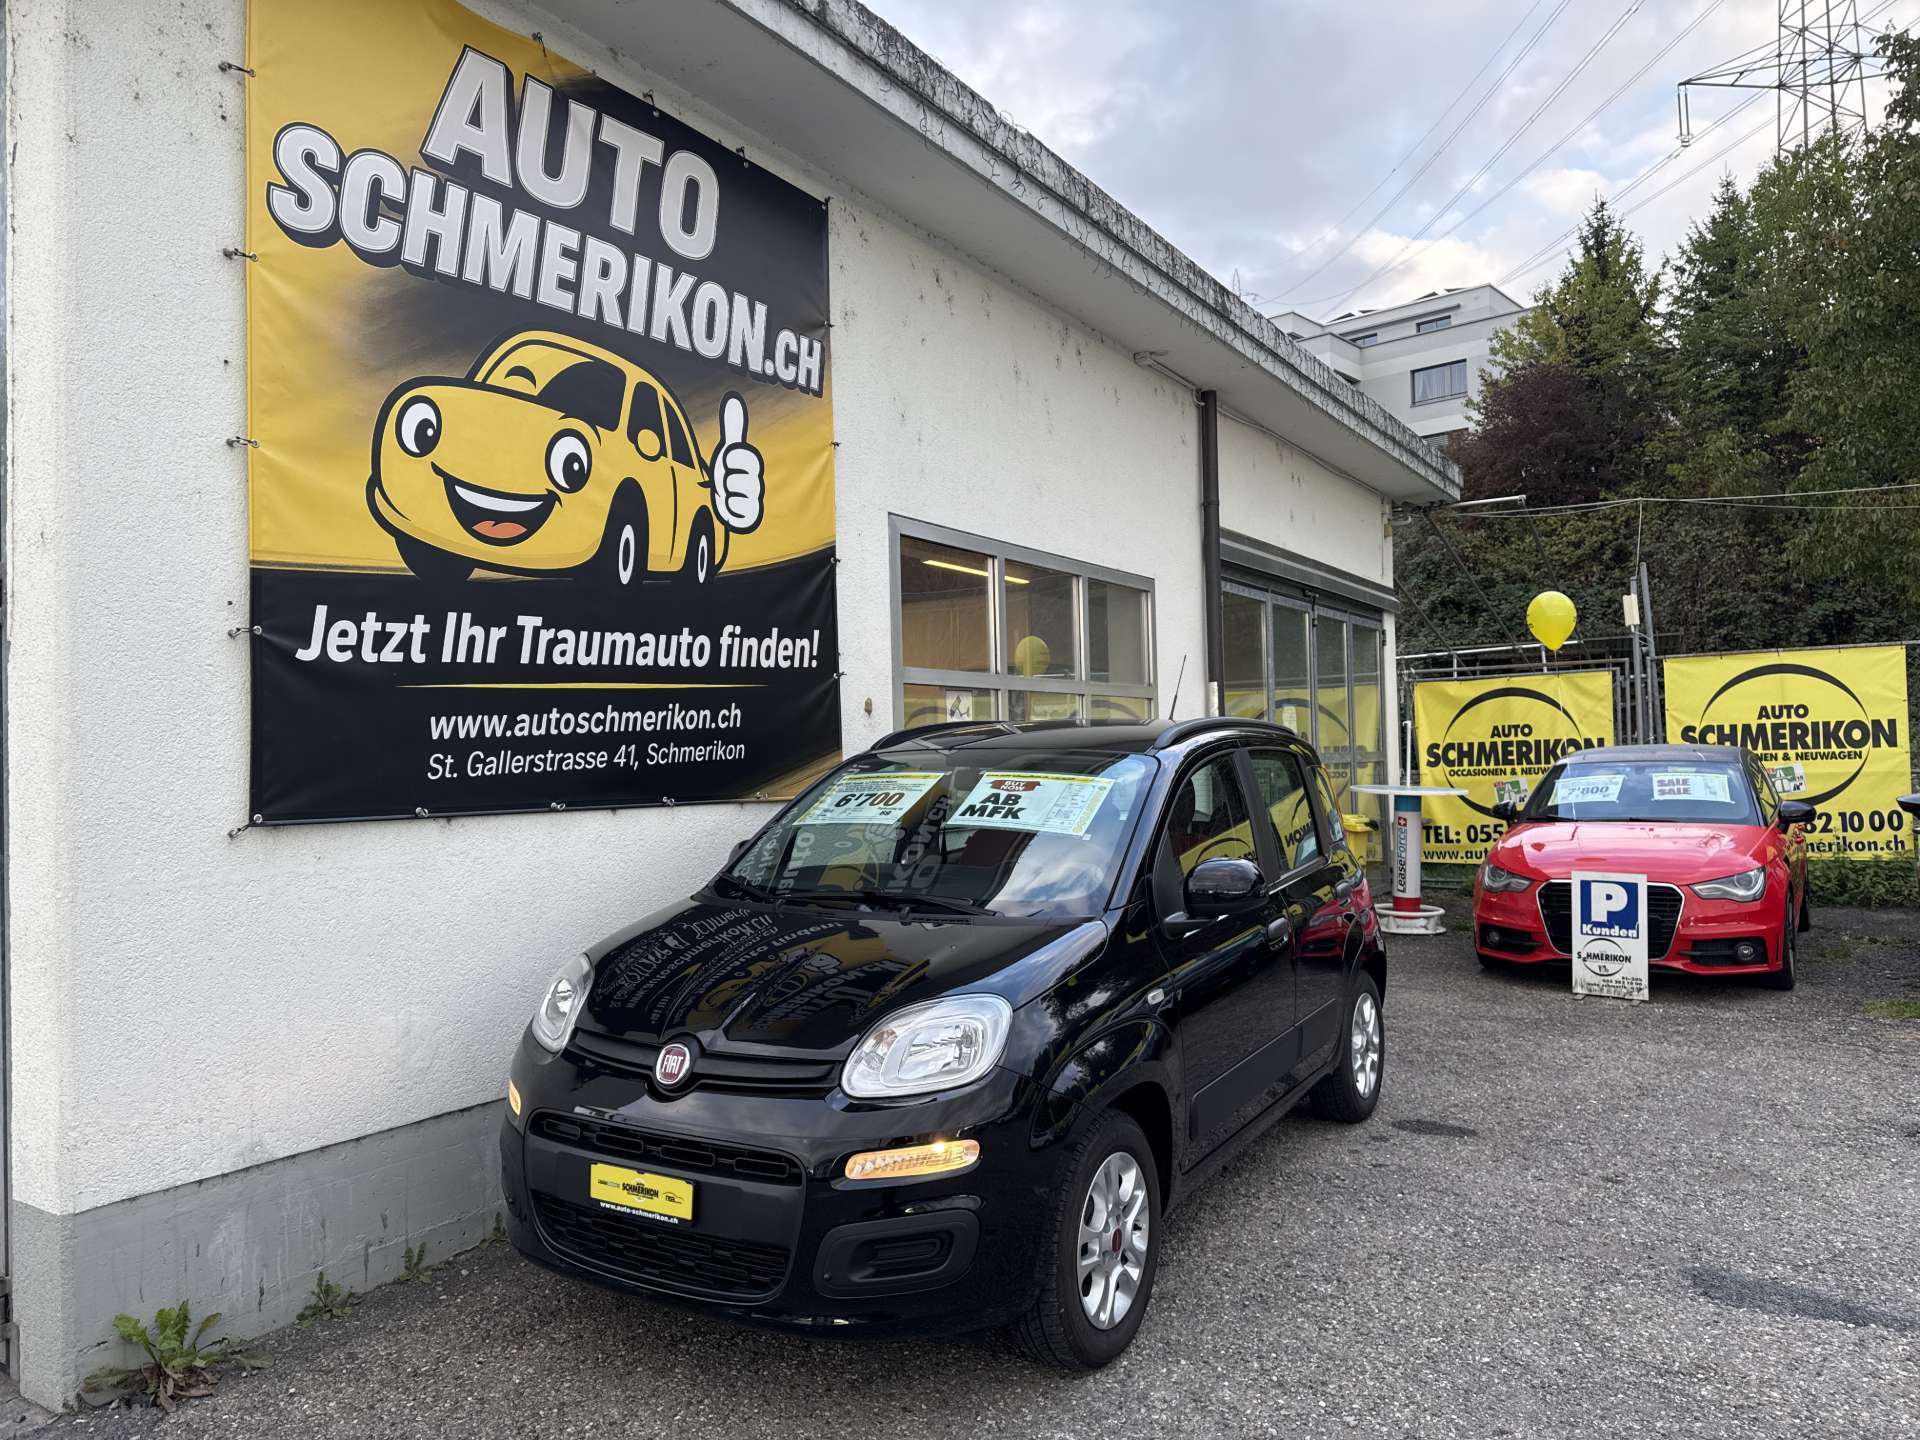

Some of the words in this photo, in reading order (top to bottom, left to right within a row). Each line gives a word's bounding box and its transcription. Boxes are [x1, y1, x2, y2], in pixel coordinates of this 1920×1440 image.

[425, 46, 720, 261] AUTO
[269, 124, 825, 391] SCHMERIKON.CH
[295, 604, 430, 664] Jetzt
[441, 611, 506, 663] Ihr
[517, 615, 711, 667] Traumauto
[719, 624, 820, 668] finden!
[1757, 704, 1809, 720] AUTO
[429, 703, 742, 740] www.autoschmerikon.ch
[1490, 724, 1533, 739] AUTO
[1680, 718, 1898, 751] SCHMERIKON
[427, 754, 458, 780] St.
[466, 747, 608, 777] Gallerstrasse
[613, 745, 639, 770] 41,
[646, 740, 746, 765] Schmerikon
[1782, 752, 1791, 761] &
[1795, 750, 1863, 762] NEUWAGEN
[1449, 768, 1507, 777] OCCASIONEN
[1510, 768, 1518, 776] &
[1656, 777, 1690, 787] SALE
[834, 791, 905, 808] 6'700
[980, 793, 1023, 806] AB
[1657, 787, 1691, 796] SALE
[958, 804, 1026, 820] MFK
[1422, 825, 1461, 844] TEL:
[1396, 827, 1408, 893] LeaseForce
[1590, 882, 1628, 923] P
[1581, 923, 1638, 938] Kunden
[661, 1053, 684, 1076] FIAT
[622, 1182, 659, 1199] SCHMERIKON
